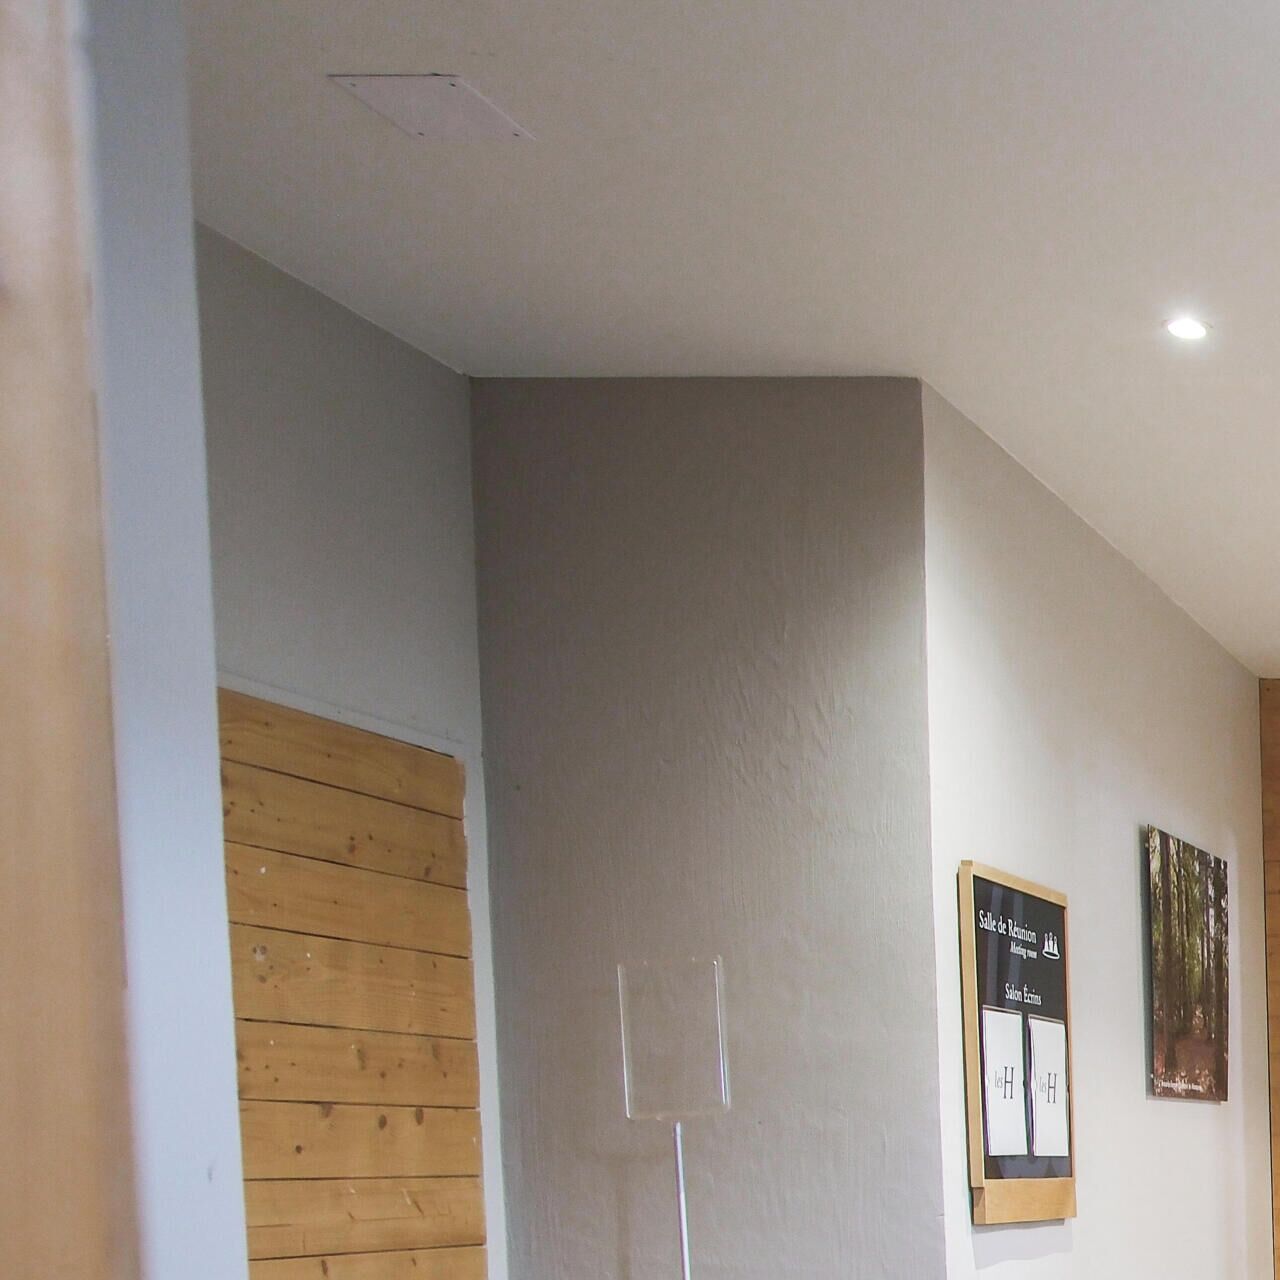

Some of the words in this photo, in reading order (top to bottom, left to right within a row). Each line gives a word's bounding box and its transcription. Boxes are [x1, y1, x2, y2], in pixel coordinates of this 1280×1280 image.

[979, 909, 997, 932] Salle
[997, 915, 1007, 935] de
[1007, 918, 1037, 943] Réunion
[1010, 941, 1026, 959] Meeting
[1005, 982, 1023, 1002] Salon
[1023, 984, 1041, 1005] Écrins
